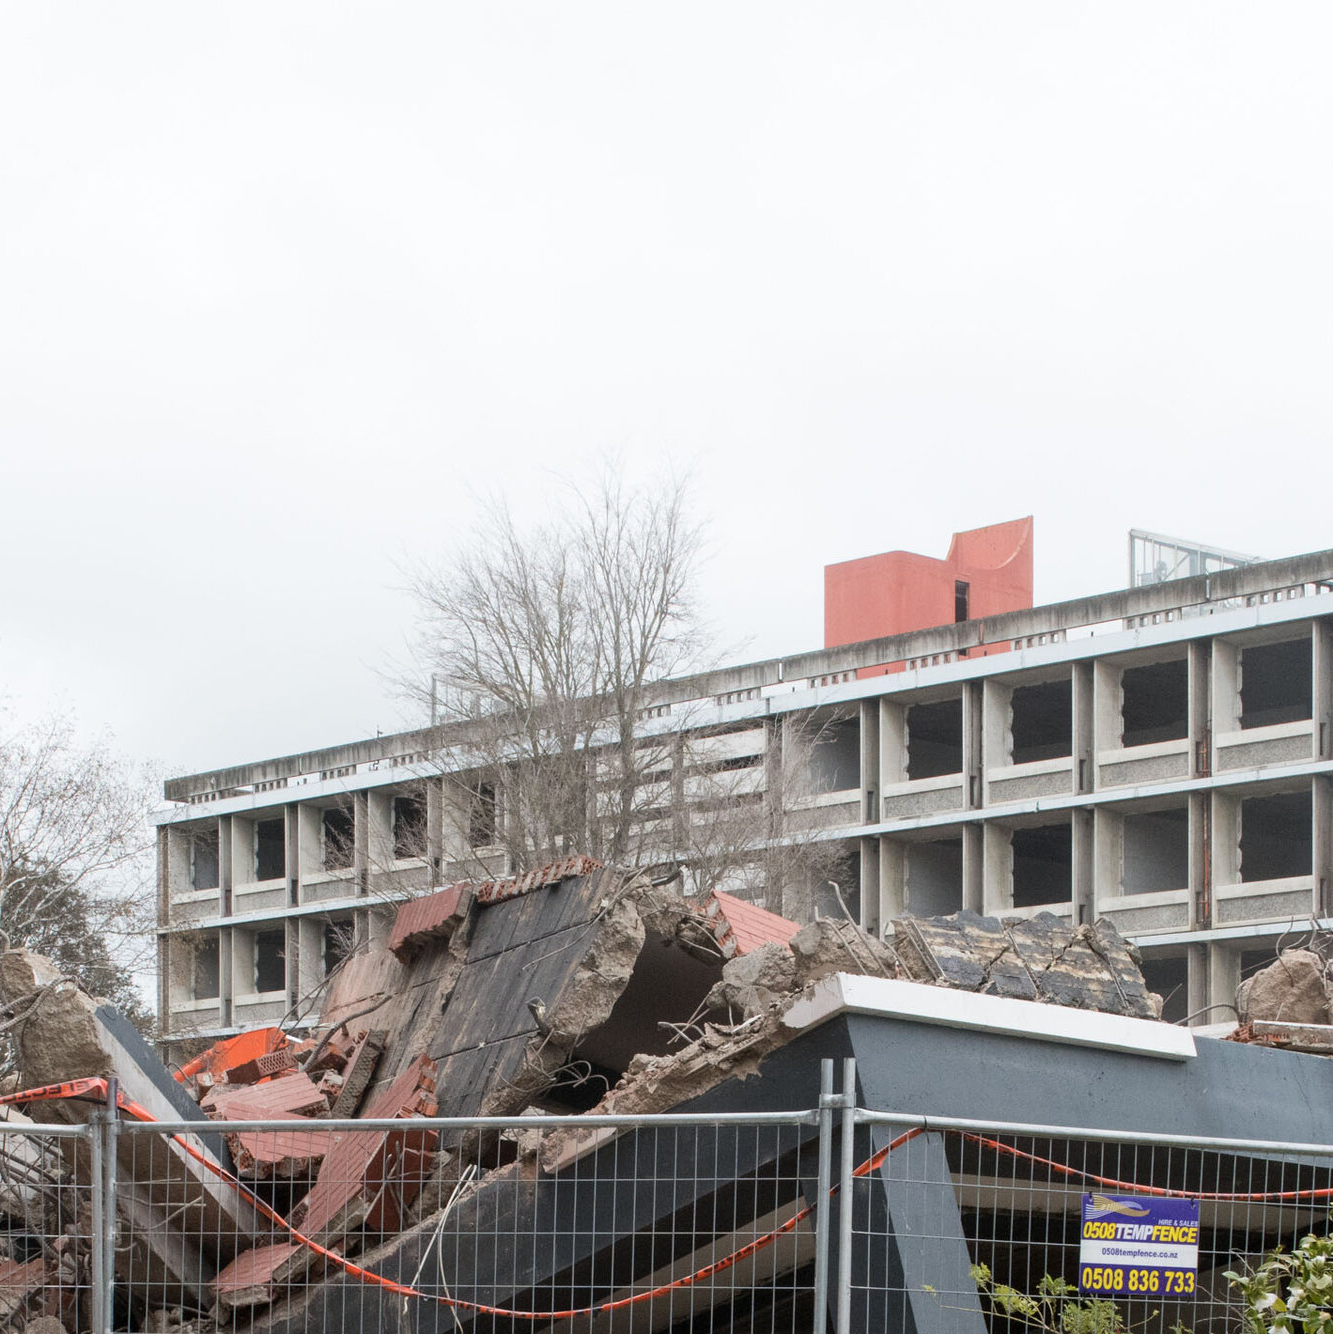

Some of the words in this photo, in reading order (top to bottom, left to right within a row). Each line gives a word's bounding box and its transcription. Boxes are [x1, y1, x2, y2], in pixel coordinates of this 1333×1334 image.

[1179, 1219, 1198, 1227] SALES
[1083, 1221, 1197, 1243] 0508TEMPFENCE
[1101, 1247, 1178, 1259] 0508tempfence.co.nz
[1082, 1266, 1124, 1291] 0508
[1128, 1269, 1160, 1292] 836
[1164, 1271, 1195, 1293] 733
